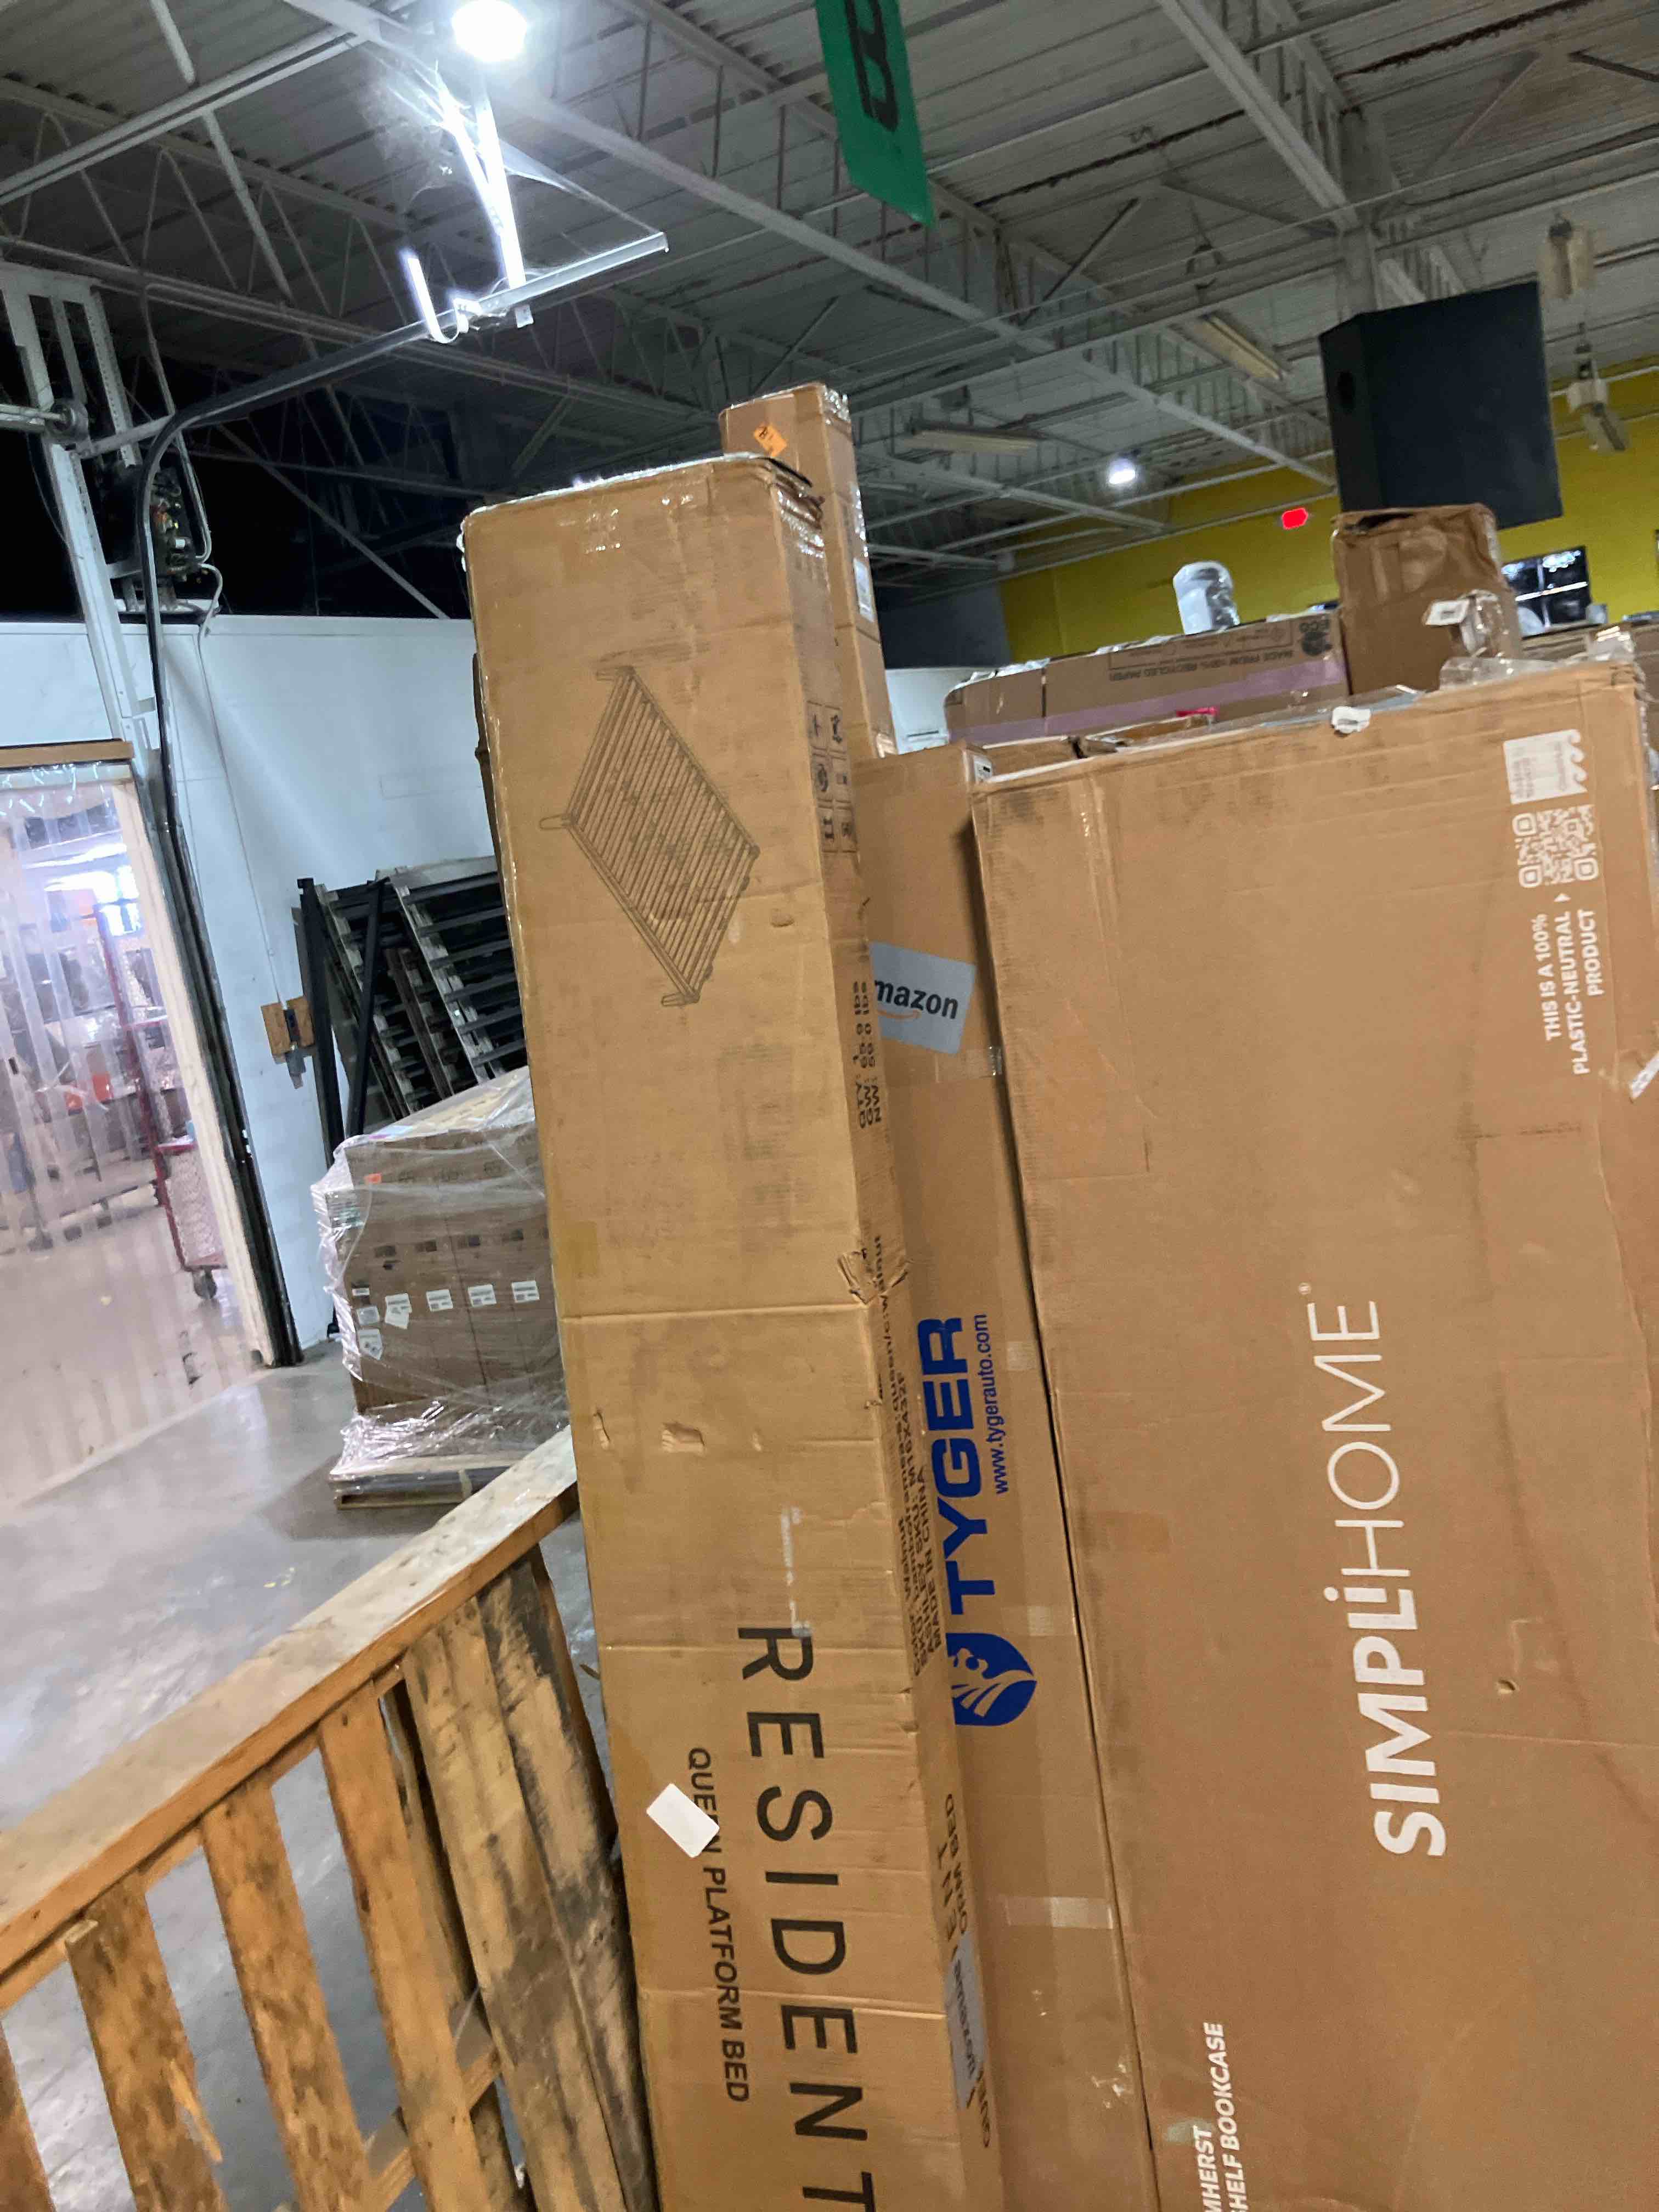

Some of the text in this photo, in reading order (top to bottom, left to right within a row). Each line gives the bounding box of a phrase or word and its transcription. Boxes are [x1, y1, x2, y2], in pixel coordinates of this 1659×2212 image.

[874, 979, 959, 1019] mazon
[1531, 913, 1562, 1041] THIS IS A 100%
[1554, 910, 1590, 1075] PLASTIC-NEUTRAL
[1577, 909, 1605, 996] PRODUCT
[917, 1316, 995, 1616] TYGER
[974, 1313, 1009, 1495] www.tygerauto.com
[917, 1562, 934, 1654] ASHLEY
[918, 1466, 942, 1648] MADE IN CHINA
[703, 1866, 742, 2030] PLATFORM
[723, 2037, 750, 2102] BED
[1193, 2125, 1222, 2212] MHERST
[1203, 2022, 1249, 2212] HELF BOOKCASE
